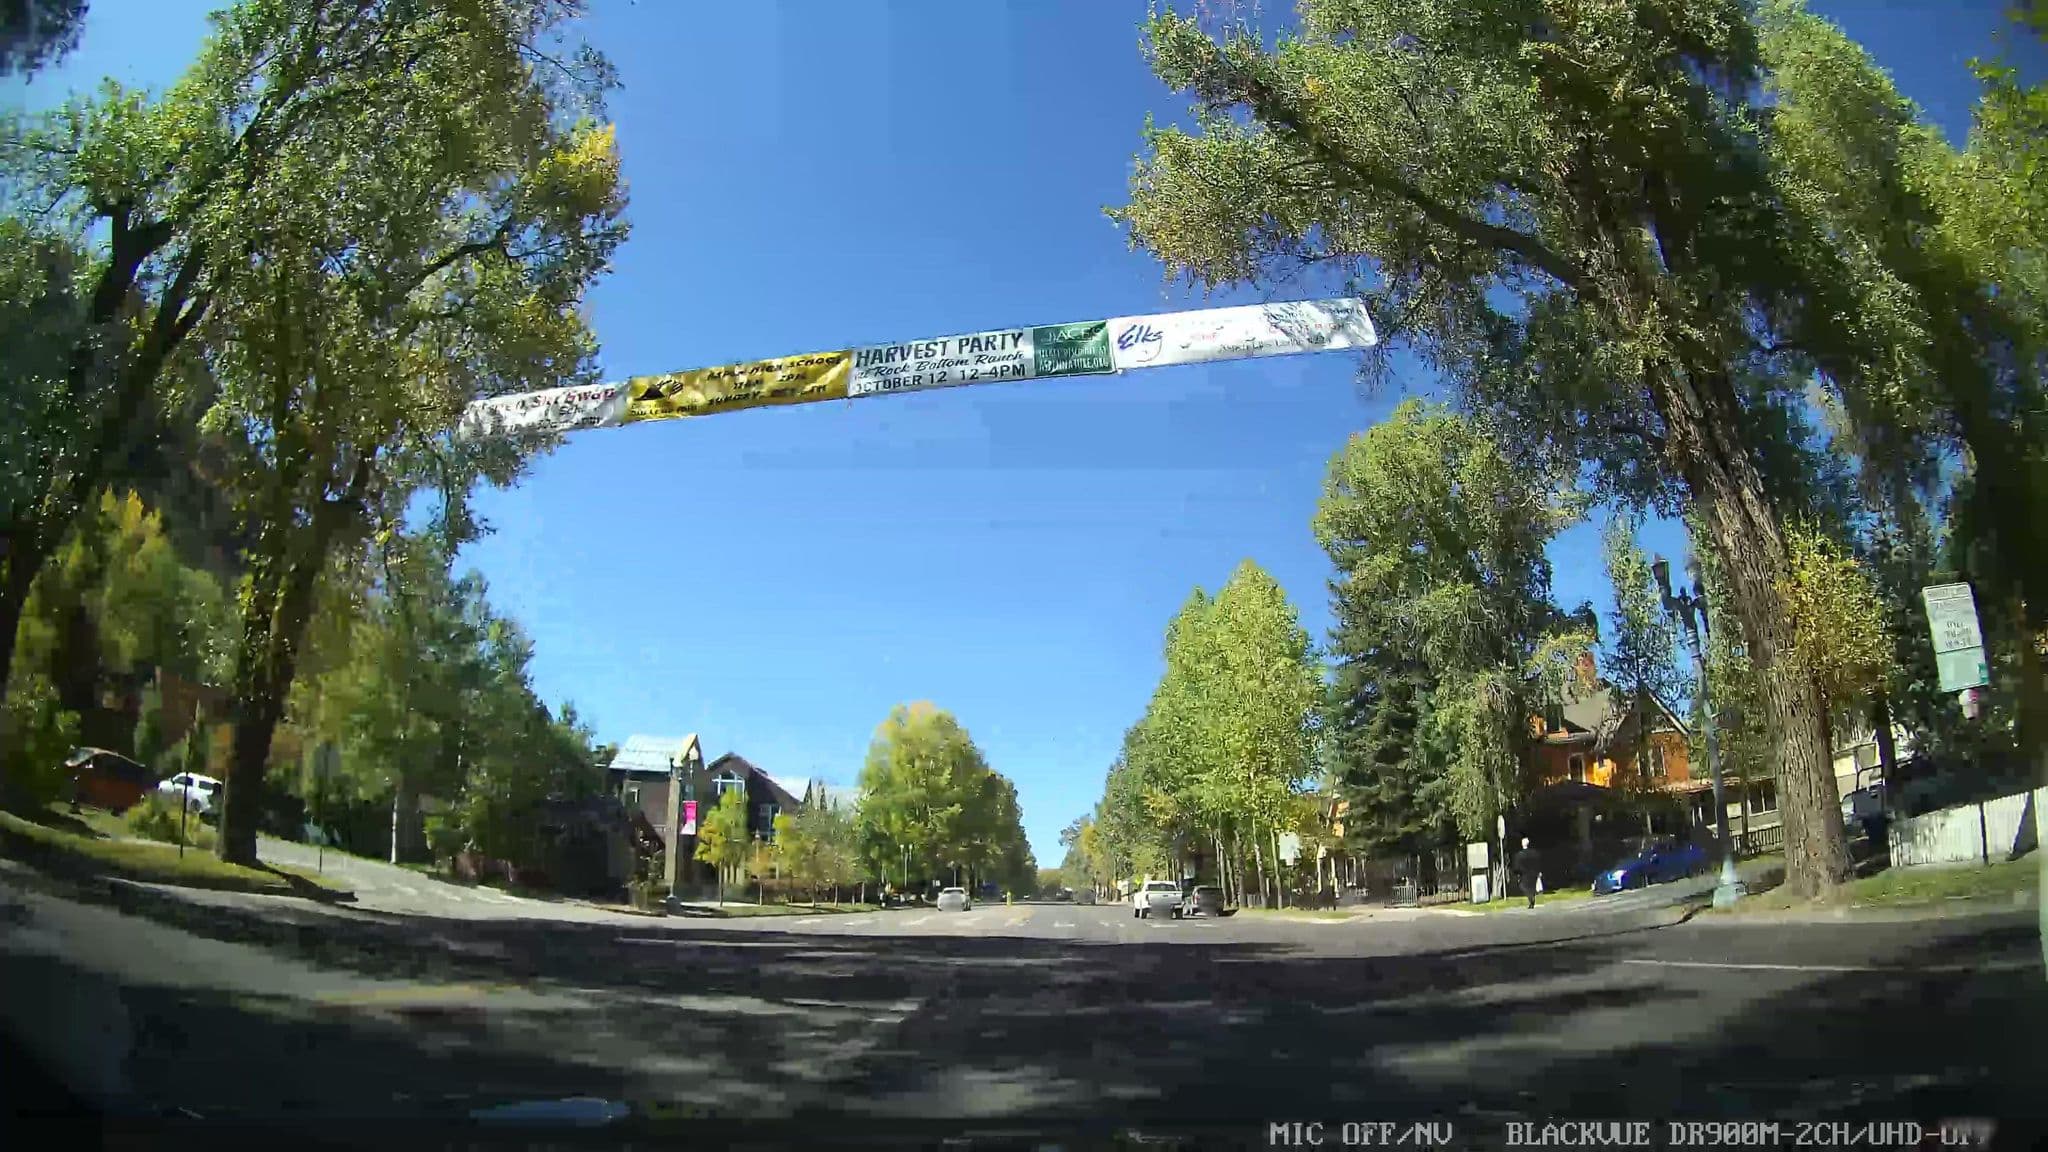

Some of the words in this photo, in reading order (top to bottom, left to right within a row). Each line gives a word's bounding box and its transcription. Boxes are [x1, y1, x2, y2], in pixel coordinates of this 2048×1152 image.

[856, 341, 950, 368] HARVEST
[958, 332, 1023, 355] PARTY
[1117, 325, 1163, 350] Elks
[868, 363, 910, 377] Rock
[915, 359, 970, 372] Bottom
[974, 351, 1024, 366] Ranch
[854, 375, 923, 393] OCTOBER
[928, 371, 948, 384] 12
[960, 364, 1026, 381] 12-4PM
